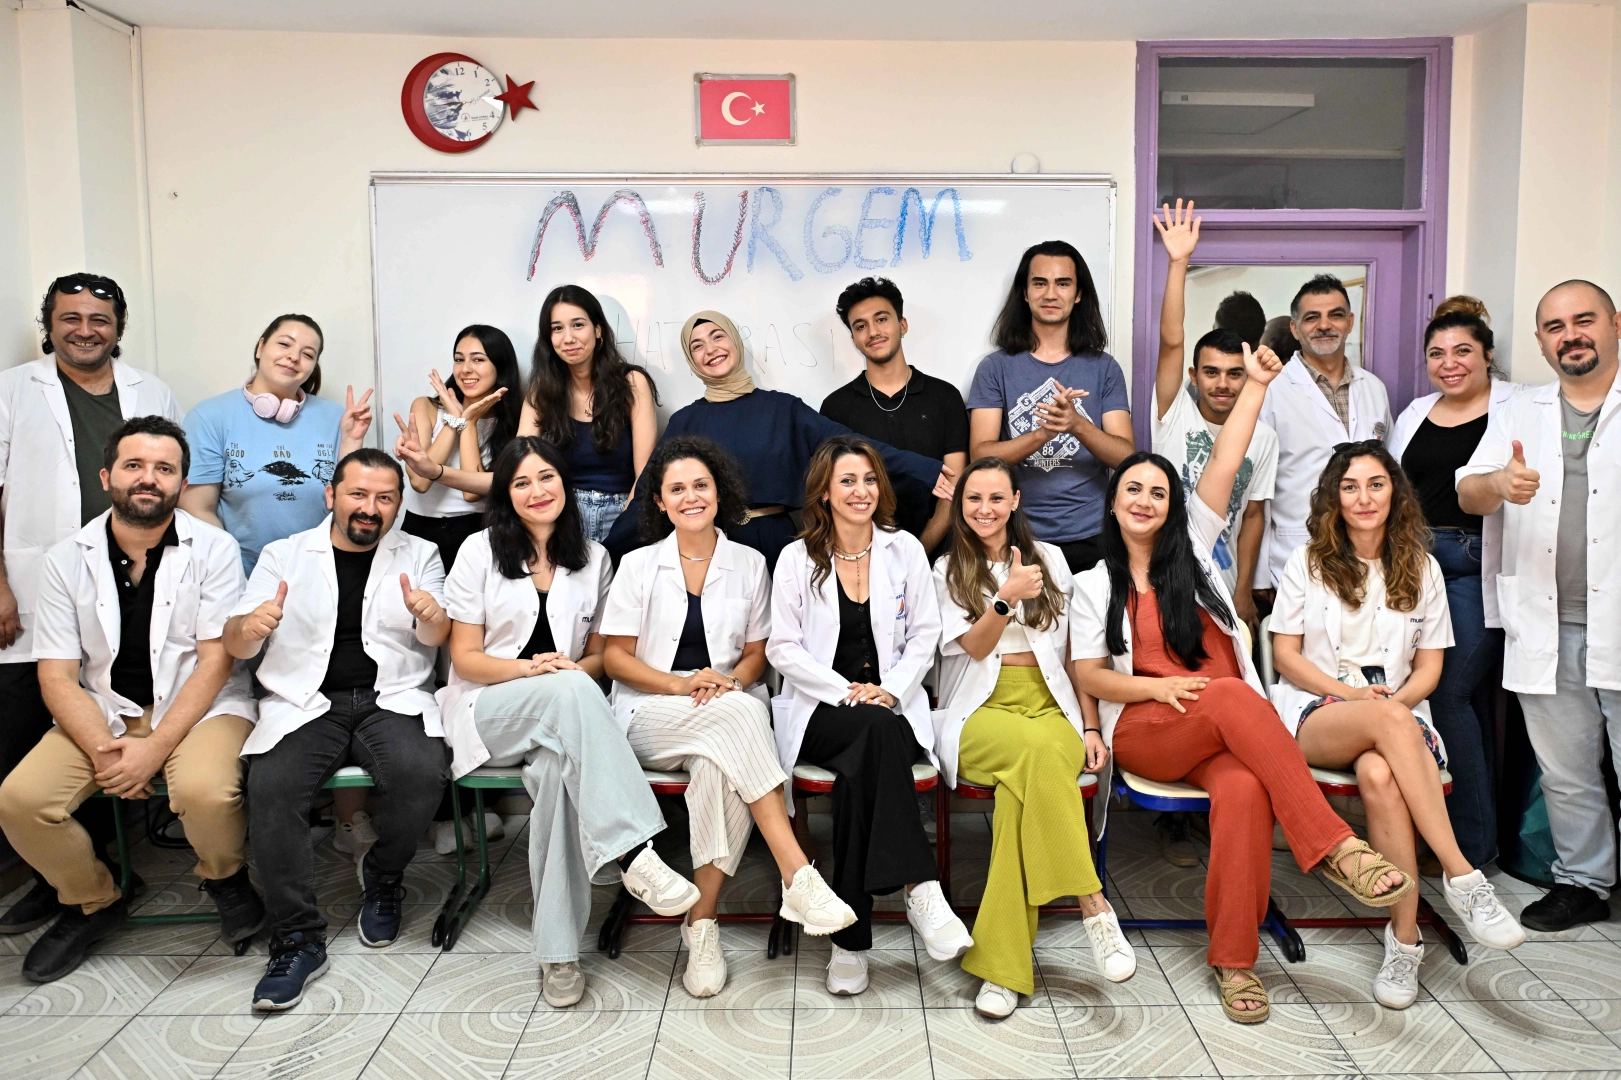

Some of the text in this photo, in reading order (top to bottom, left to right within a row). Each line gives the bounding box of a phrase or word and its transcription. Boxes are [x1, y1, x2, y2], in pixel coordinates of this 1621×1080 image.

[474, 70, 478, 78] 1
[490, 111, 494, 119] 4
[482, 122, 487, 130] 5
[526, 186, 973, 286] MURGEM
[225, 448, 245, 458] GOOD
[273, 450, 291, 458] BAD
[317, 449, 334, 458] UGLY
[1042, 446, 1054, 456] 88
